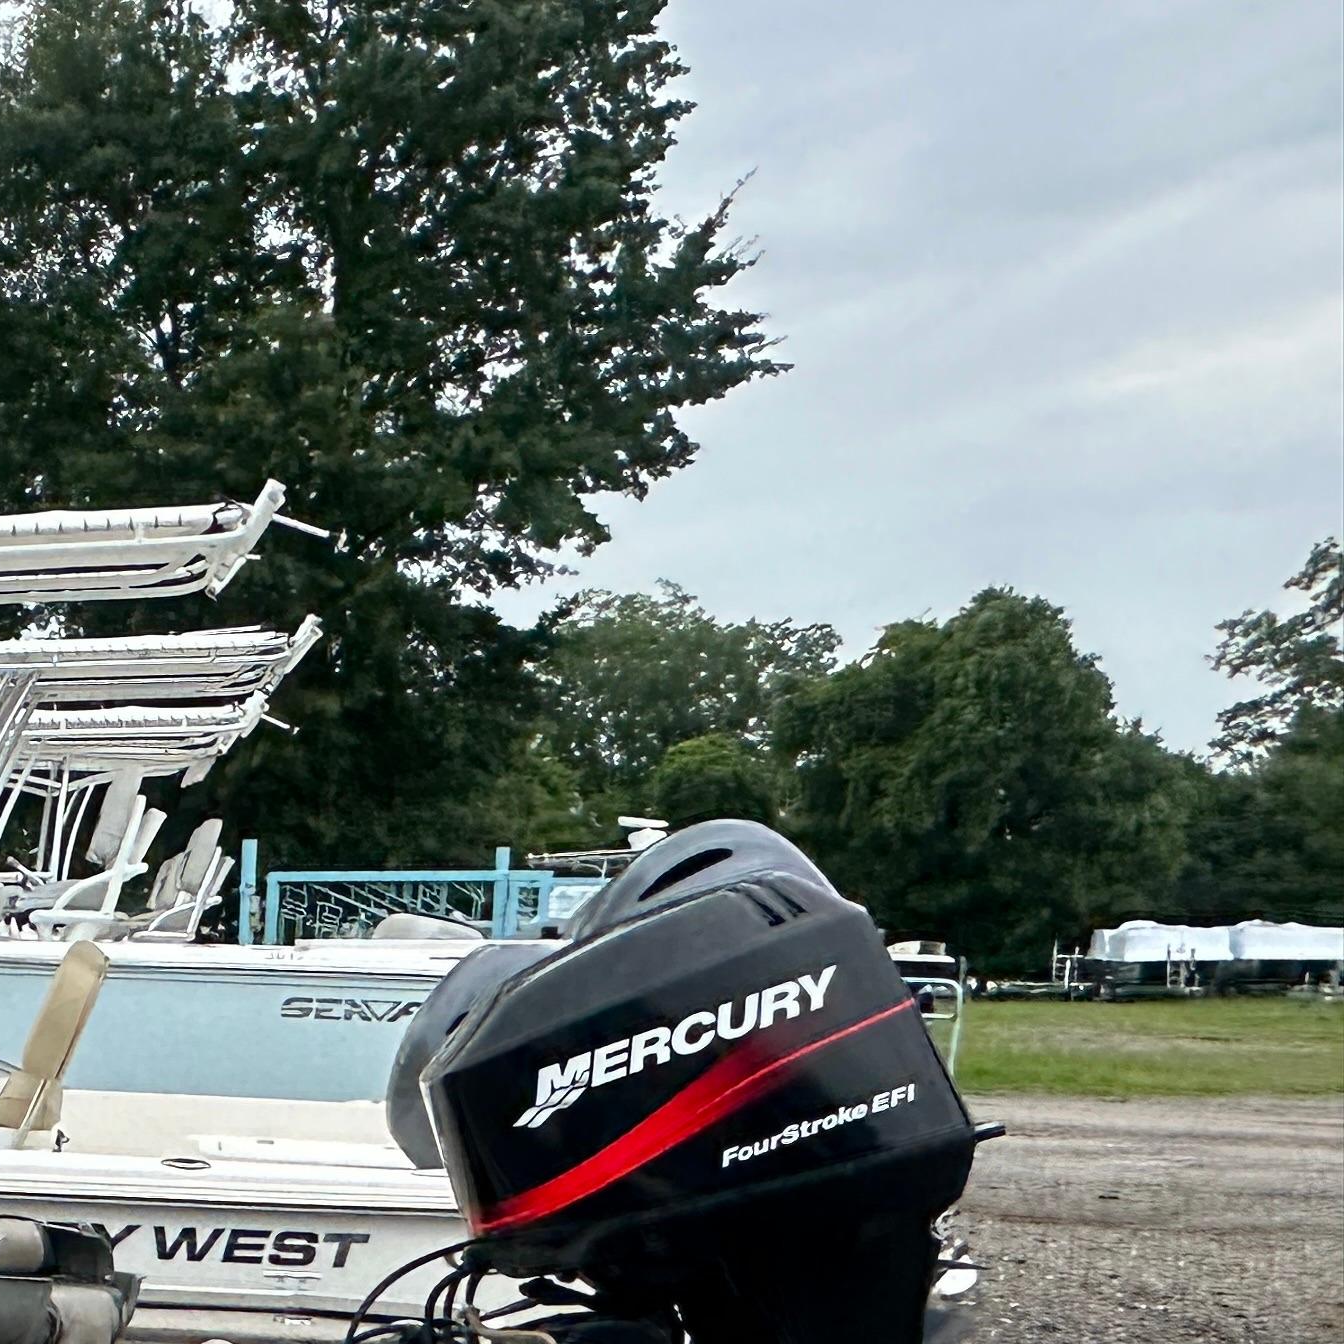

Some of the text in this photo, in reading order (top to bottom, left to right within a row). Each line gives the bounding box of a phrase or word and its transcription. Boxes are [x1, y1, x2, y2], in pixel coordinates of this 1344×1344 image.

[513, 965, 837, 1128] MERCURY
[722, 1083, 915, 1168] FourStroke EFI
[153, 1226, 370, 1269] WEST
